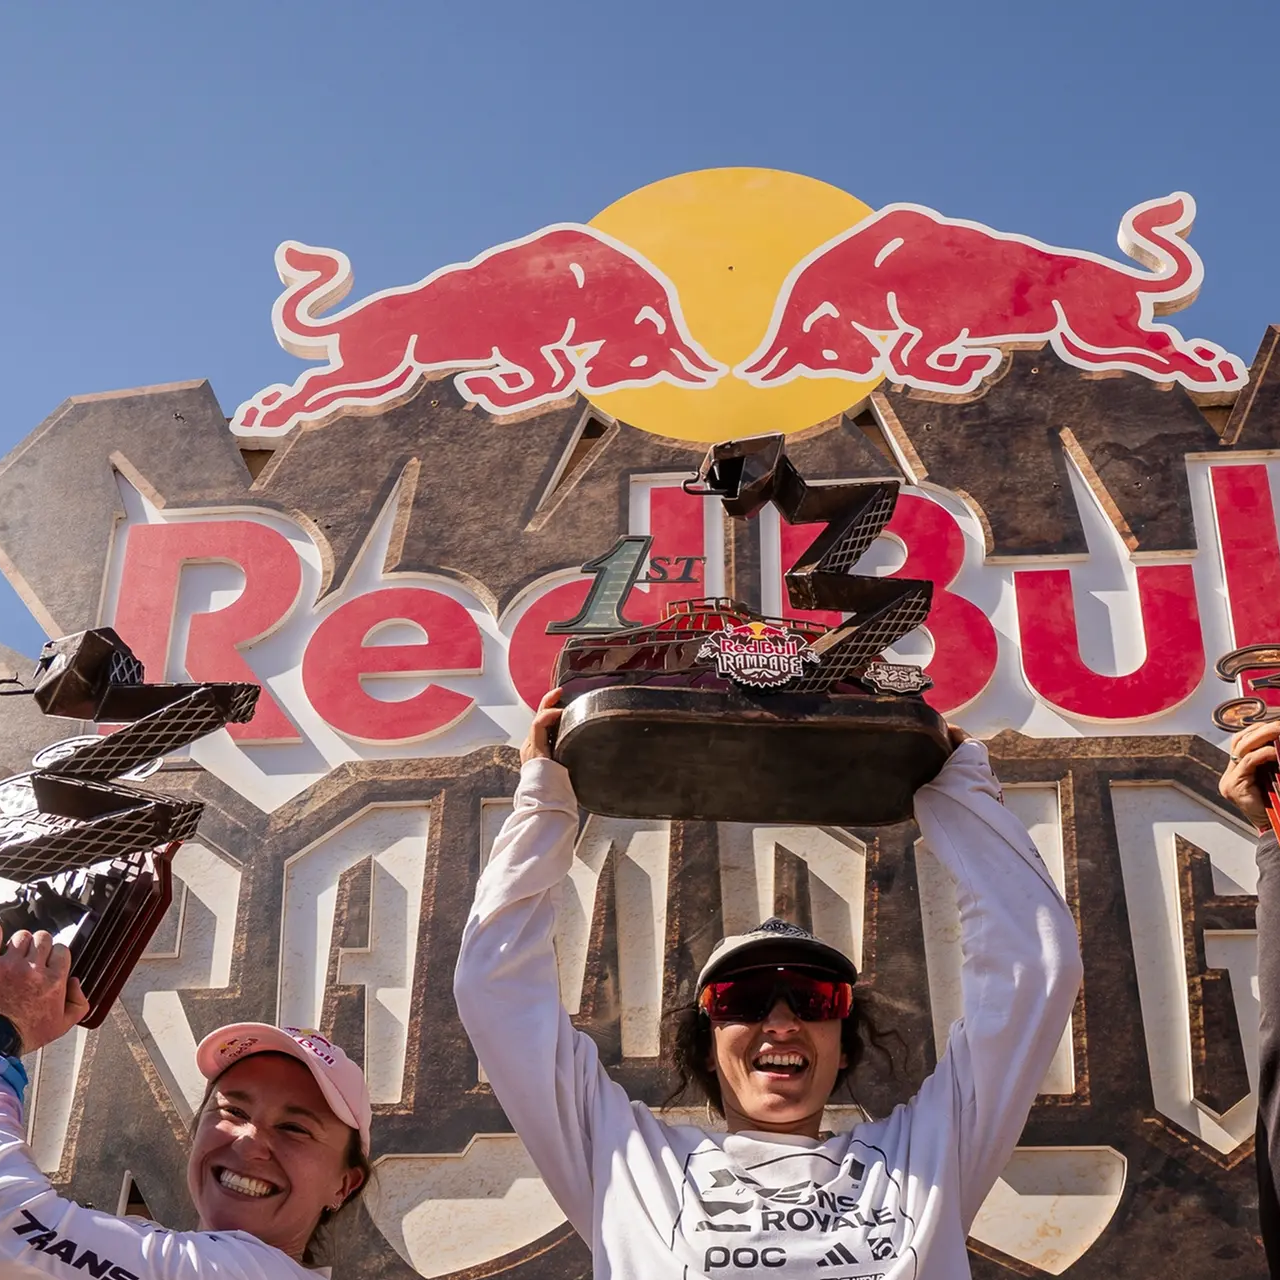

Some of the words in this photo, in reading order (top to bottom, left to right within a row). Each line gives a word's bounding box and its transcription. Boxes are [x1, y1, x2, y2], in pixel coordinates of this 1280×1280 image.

[96, 487, 705, 744] Red
[721, 639, 760, 653] Red
[761, 640, 798, 655] Bull
[720, 652, 804, 677] RAMPAGE
[761, 1206, 897, 1233] ROYALE
